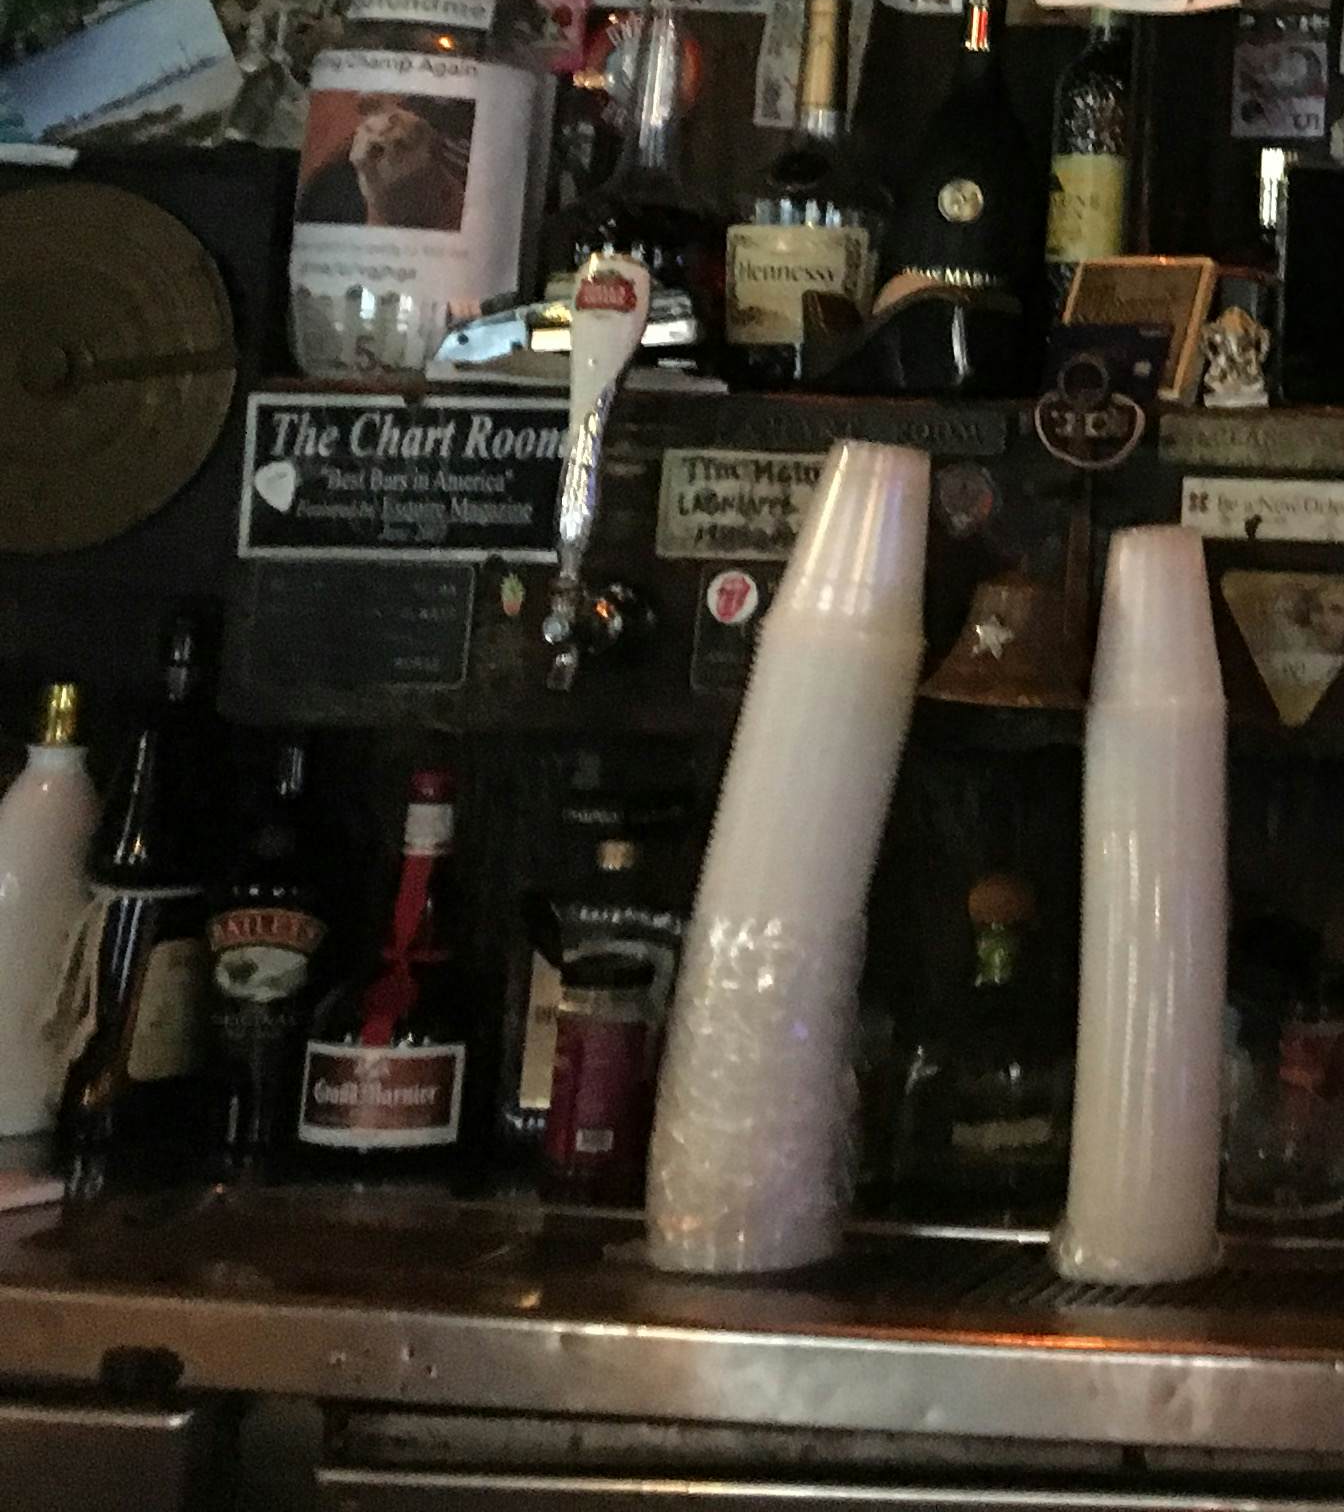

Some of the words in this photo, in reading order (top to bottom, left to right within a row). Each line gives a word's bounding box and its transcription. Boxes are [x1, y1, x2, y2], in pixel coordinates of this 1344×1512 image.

[739, 261, 836, 283] Hennessy
[270, 413, 338, 458] The
[349, 412, 456, 458] Chart
[463, 413, 570, 460] Room
[1256, 496, 1299, 515] New
